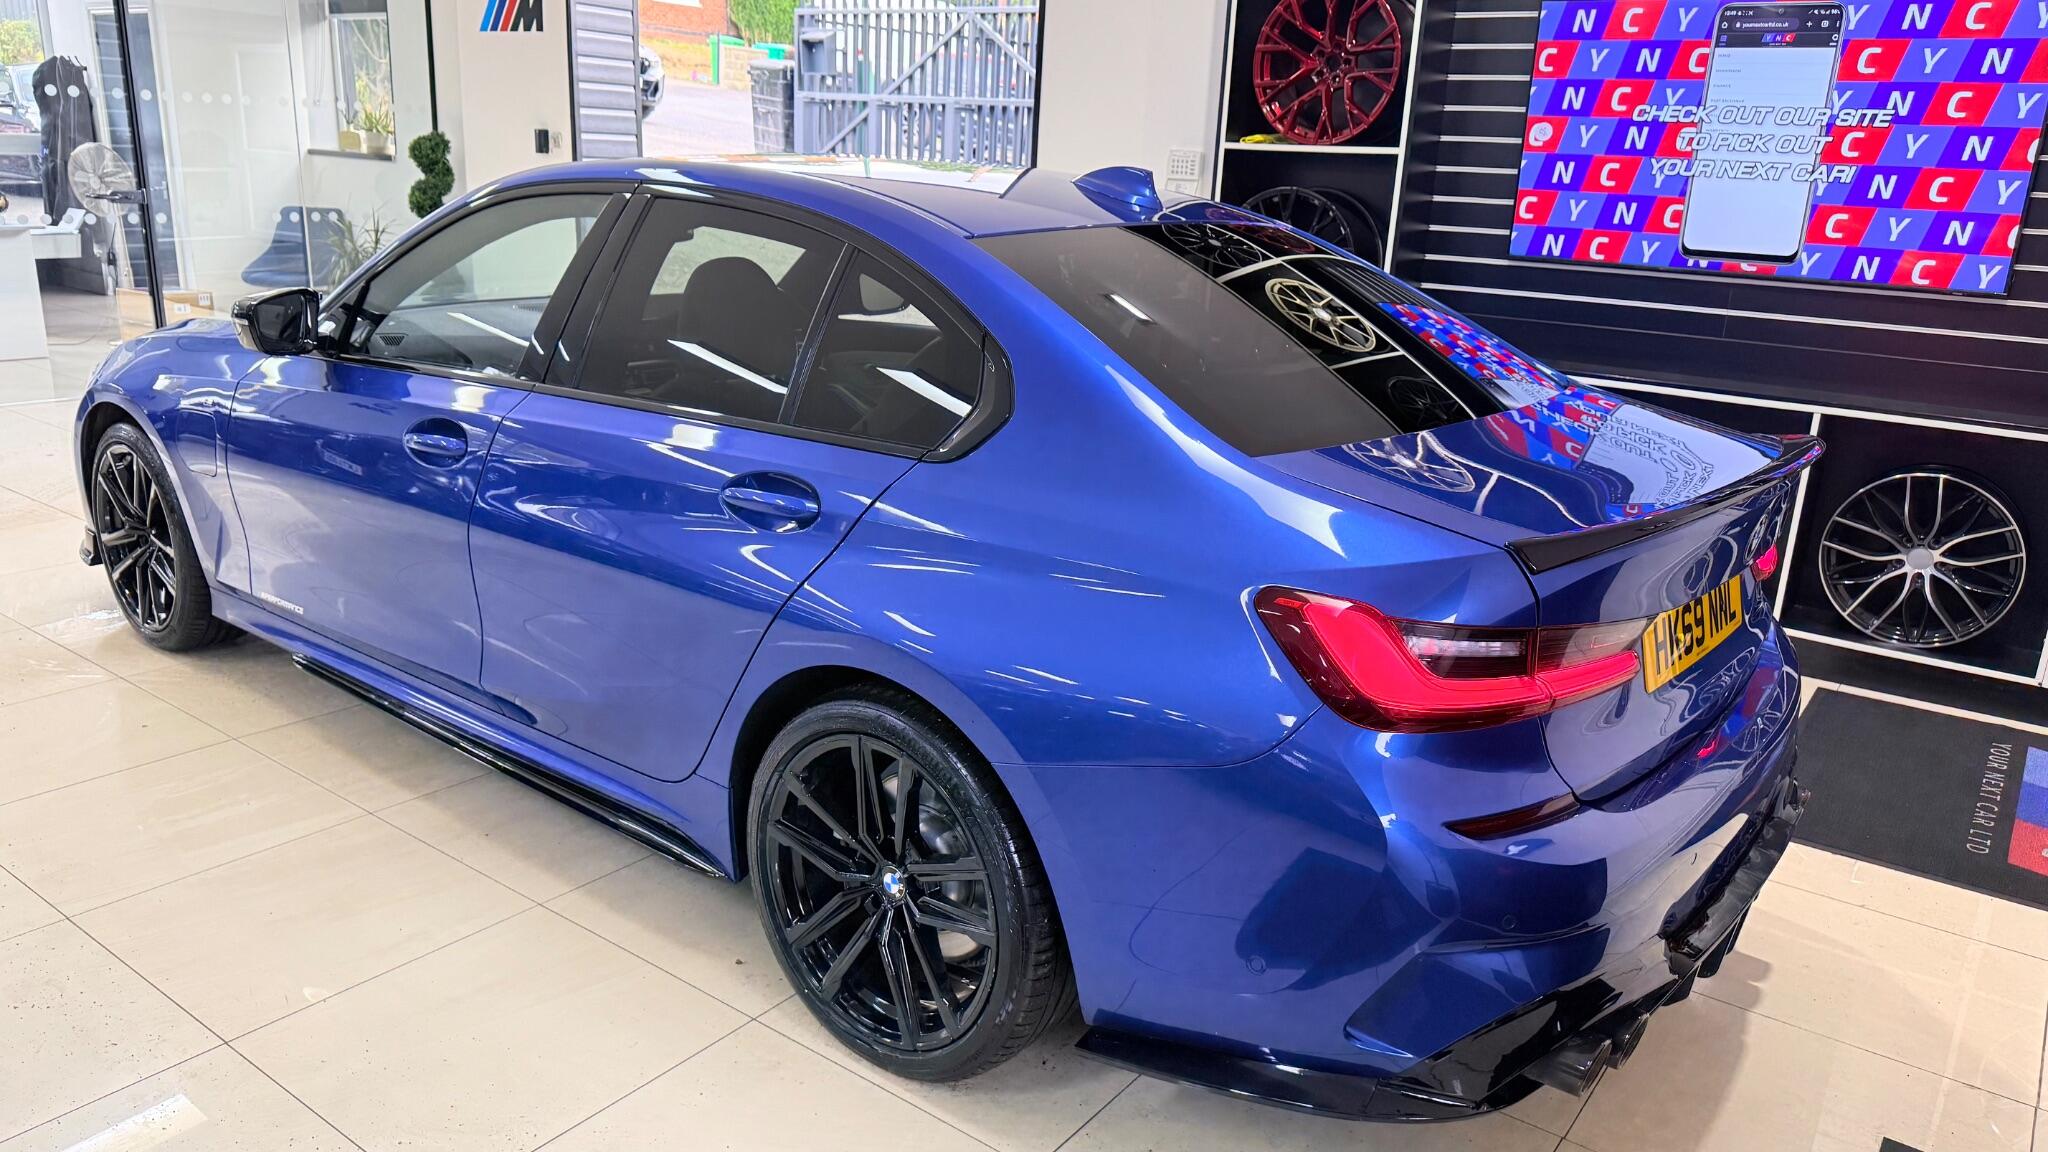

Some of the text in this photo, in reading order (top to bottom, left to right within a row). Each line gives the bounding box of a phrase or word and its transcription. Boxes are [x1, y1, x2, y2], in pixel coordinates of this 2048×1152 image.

[1632, 104, 1896, 128] CHECK OUT OUR SITE
[1680, 132, 1711, 151] TO
[1712, 133, 1775, 153] PICK
[1775, 134, 1833, 154] OUT
[1650, 158, 1716, 178] YOUR
[1716, 160, 1792, 181] NEXT
[1966, 742, 2012, 854] YOUR NEXT CAR LTD
